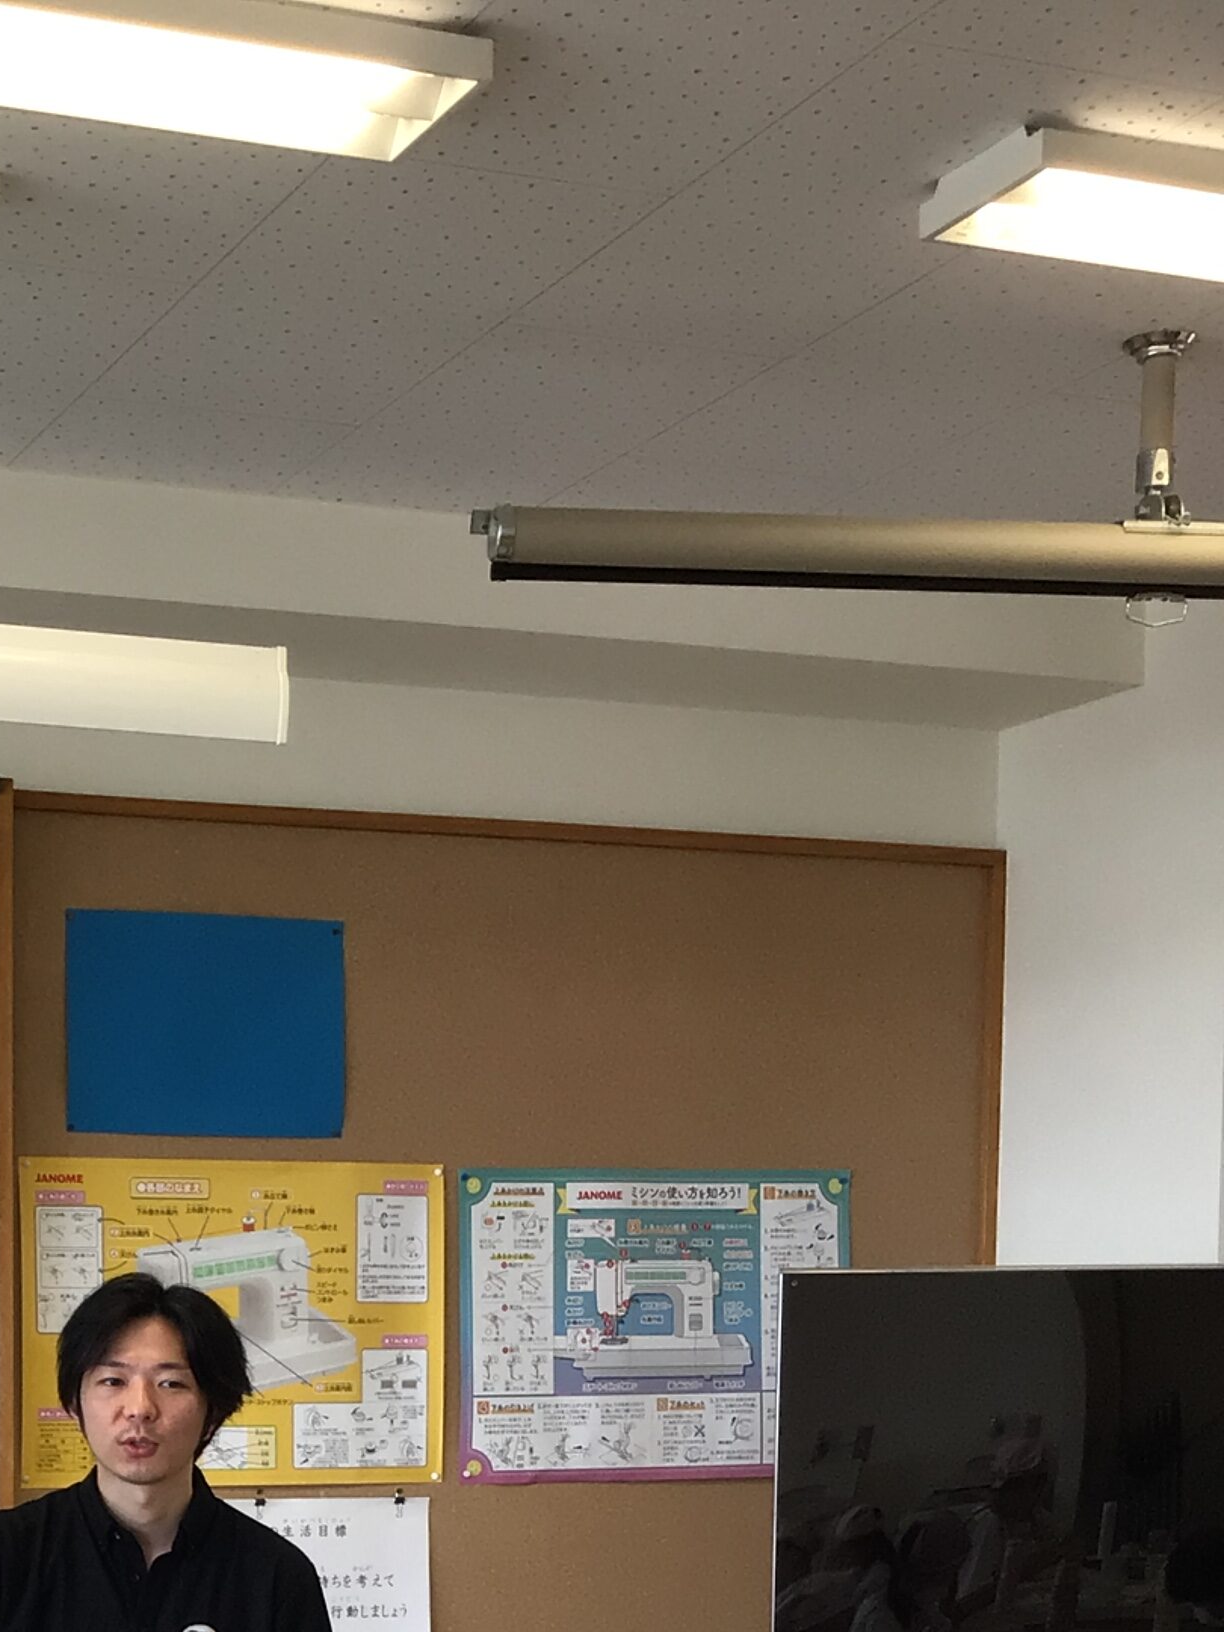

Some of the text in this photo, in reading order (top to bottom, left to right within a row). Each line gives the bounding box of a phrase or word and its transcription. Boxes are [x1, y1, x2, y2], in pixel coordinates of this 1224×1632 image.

[36, 1174, 83, 1184] JANOME
[577, 1190, 623, 1200] JANOME
[631, 1186, 741, 1200] ミシンの使い方を知ろう!
[331, 1604, 407, 1618] 行動しましょう
